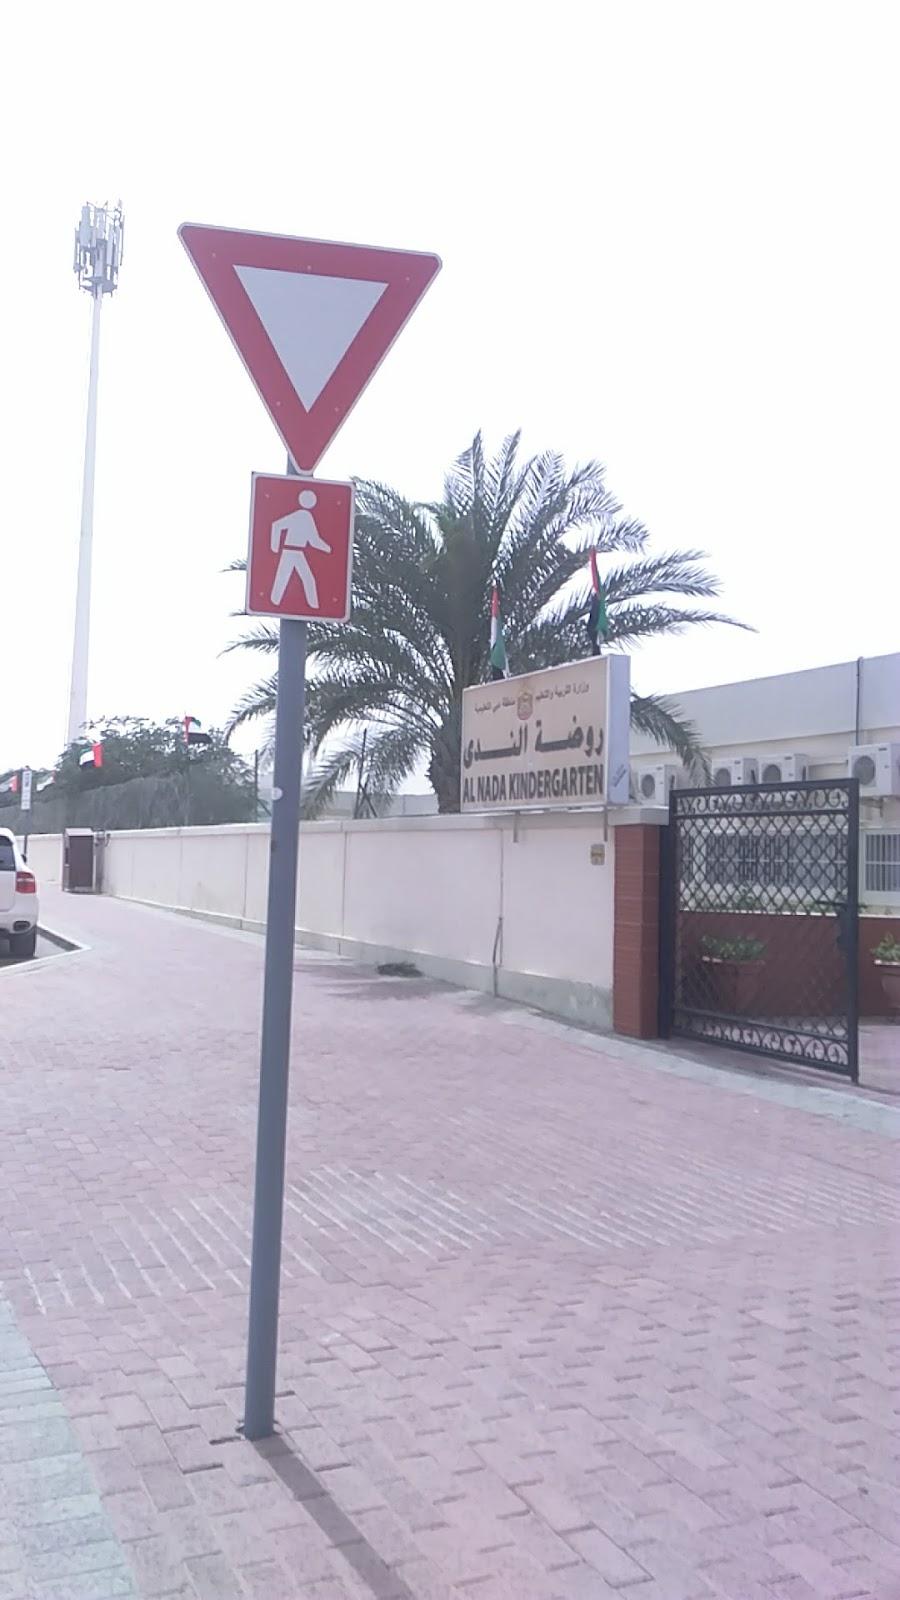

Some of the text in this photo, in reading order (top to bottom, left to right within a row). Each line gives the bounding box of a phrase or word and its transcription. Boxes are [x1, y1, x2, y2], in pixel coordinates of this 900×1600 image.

[463, 715, 604, 769] روضة الندى
[463, 778, 475, 803] AL
[477, 774, 506, 802] NADA
[509, 764, 604, 800] KINDERGARTEN
